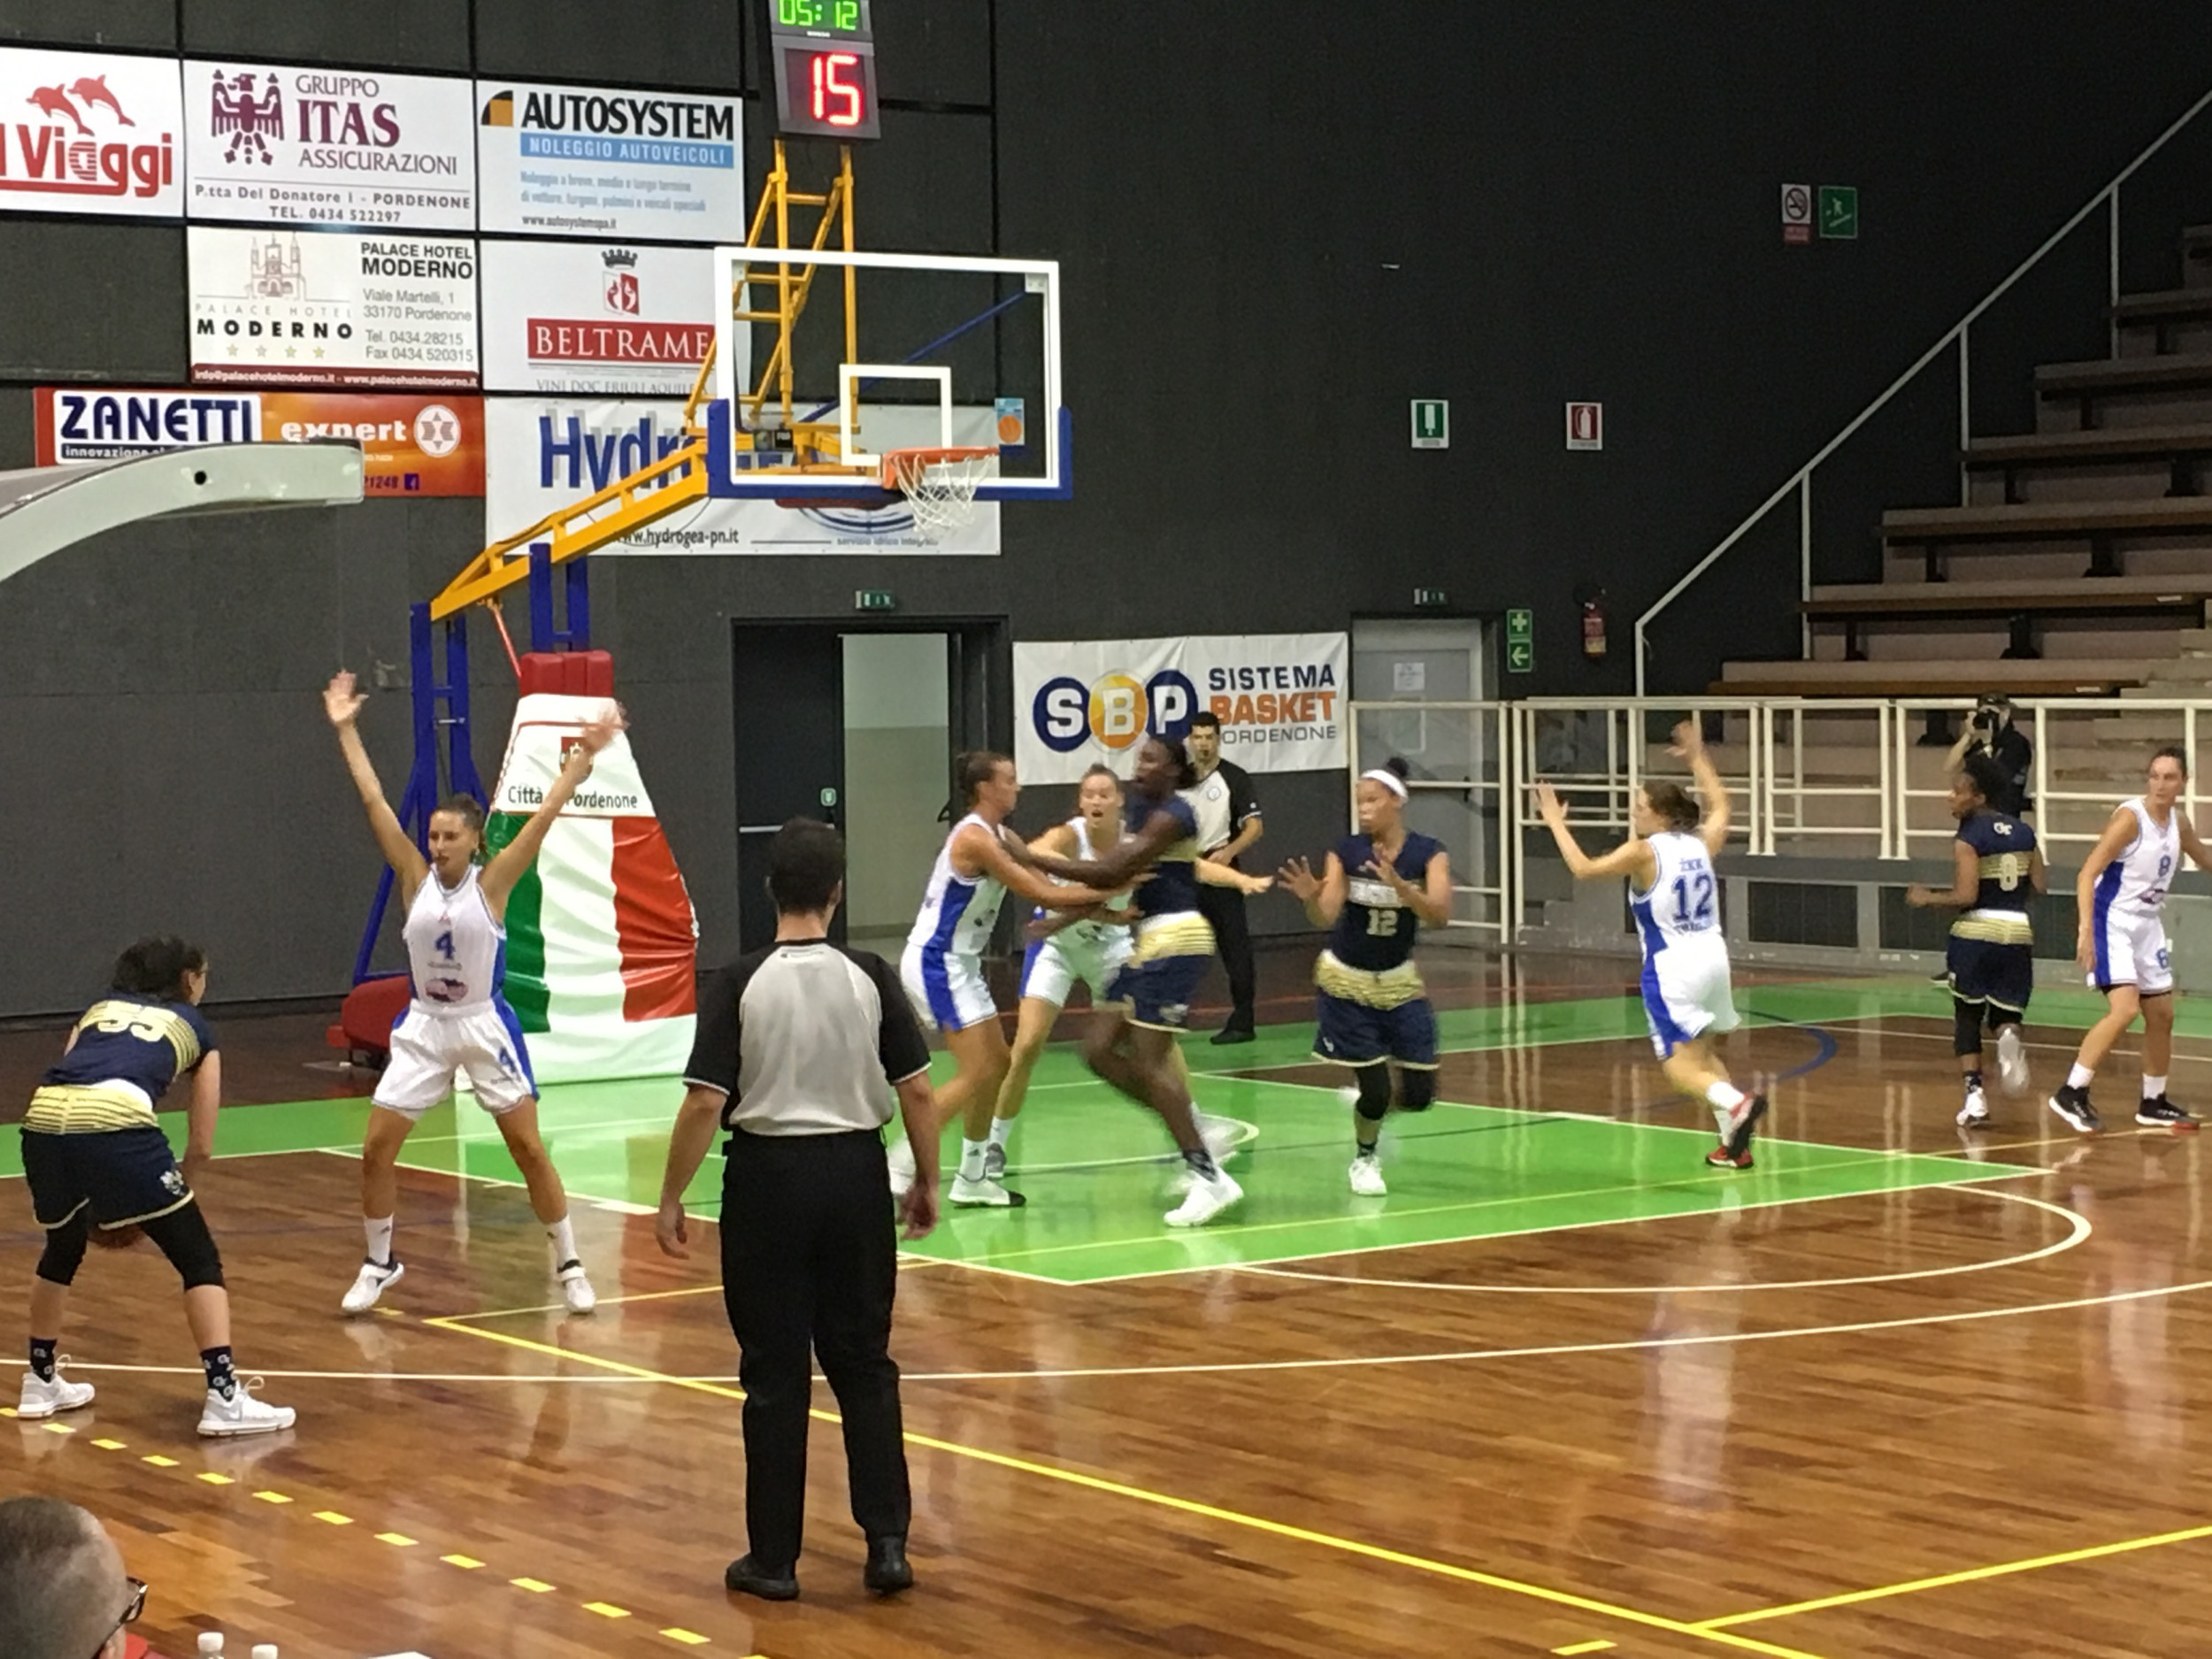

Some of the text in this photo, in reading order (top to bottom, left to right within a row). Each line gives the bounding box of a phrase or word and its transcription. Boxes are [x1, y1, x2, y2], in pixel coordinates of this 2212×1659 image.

[296, 74, 380, 97] GRUPPO
[813, 54, 860, 125] 15
[297, 98, 401, 148] ITAS
[521, 91, 733, 141] AUTOSYSTEM
[17, 124, 173, 198] Viaggi
[299, 149, 457, 175] ASSICURAZIONI
[530, 137, 725, 164] NOLEGGIO AUTOVEICOLI
[238, 186, 264, 200] Del
[270, 188, 341, 204] Donatore
[373, 193, 470, 209] PORDENONE
[270, 205, 401, 223] TEL. 0434 522297
[361, 242, 472, 259] PALACE HOTEL
[362, 257, 473, 279] MODERNO
[363, 289, 455, 305] Viale Martelli, 1
[196, 303, 352, 319] PALACE HOTEL
[364, 306, 472, 321] 33170 Pordenone
[196, 319, 353, 340] MODERNO
[366, 329, 464, 346] Tel. 0434.28215
[535, 325, 710, 359] BELTRAME
[366, 347, 388, 360] Fax
[61, 396, 253, 442] ZANETTI
[1210, 664, 1335, 691] SISTEMA
[1047, 685, 1187, 738] SBP
[1210, 691, 1337, 726] BASKET
[1221, 725, 1337, 745] ORDENONE
[508, 785, 638, 809] Città ordenone
[1671, 873, 1713, 922] 12
[1366, 909, 1397, 936] 12
[434, 930, 455, 960] 4
